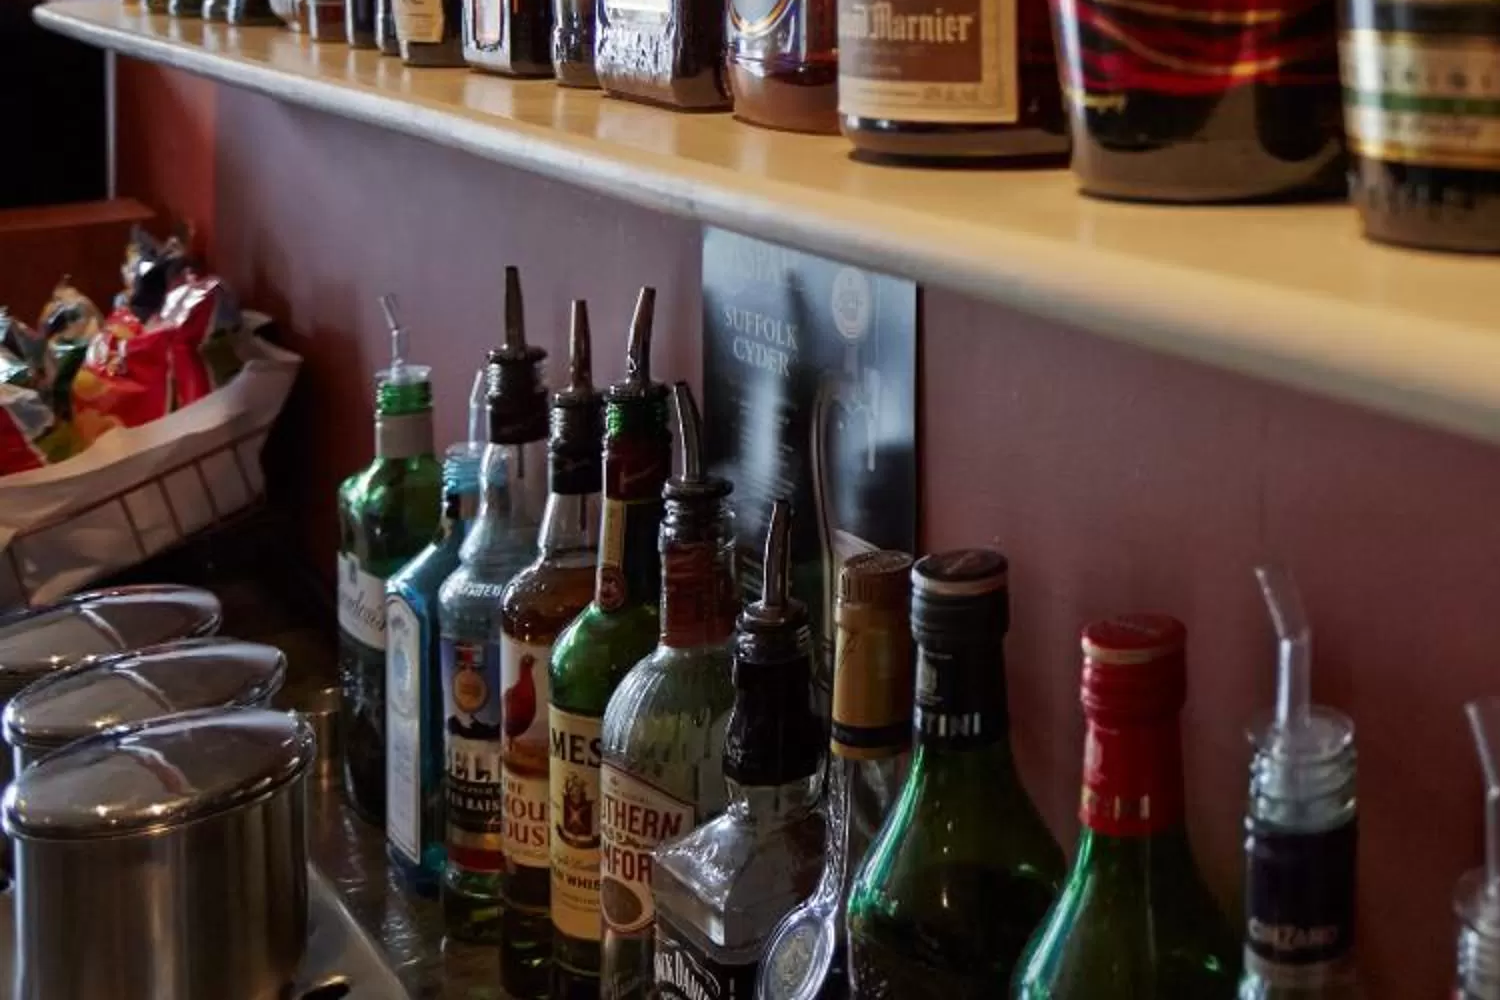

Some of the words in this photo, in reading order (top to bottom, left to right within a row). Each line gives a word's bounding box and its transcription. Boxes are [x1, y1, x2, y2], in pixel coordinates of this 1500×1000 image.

[871, 0, 974, 44] Marnier
[723, 305, 799, 351] SUFFOLK
[733, 337, 791, 377] CYDER
[926, 711, 982, 738] TINI
[552, 727, 600, 768] MES
